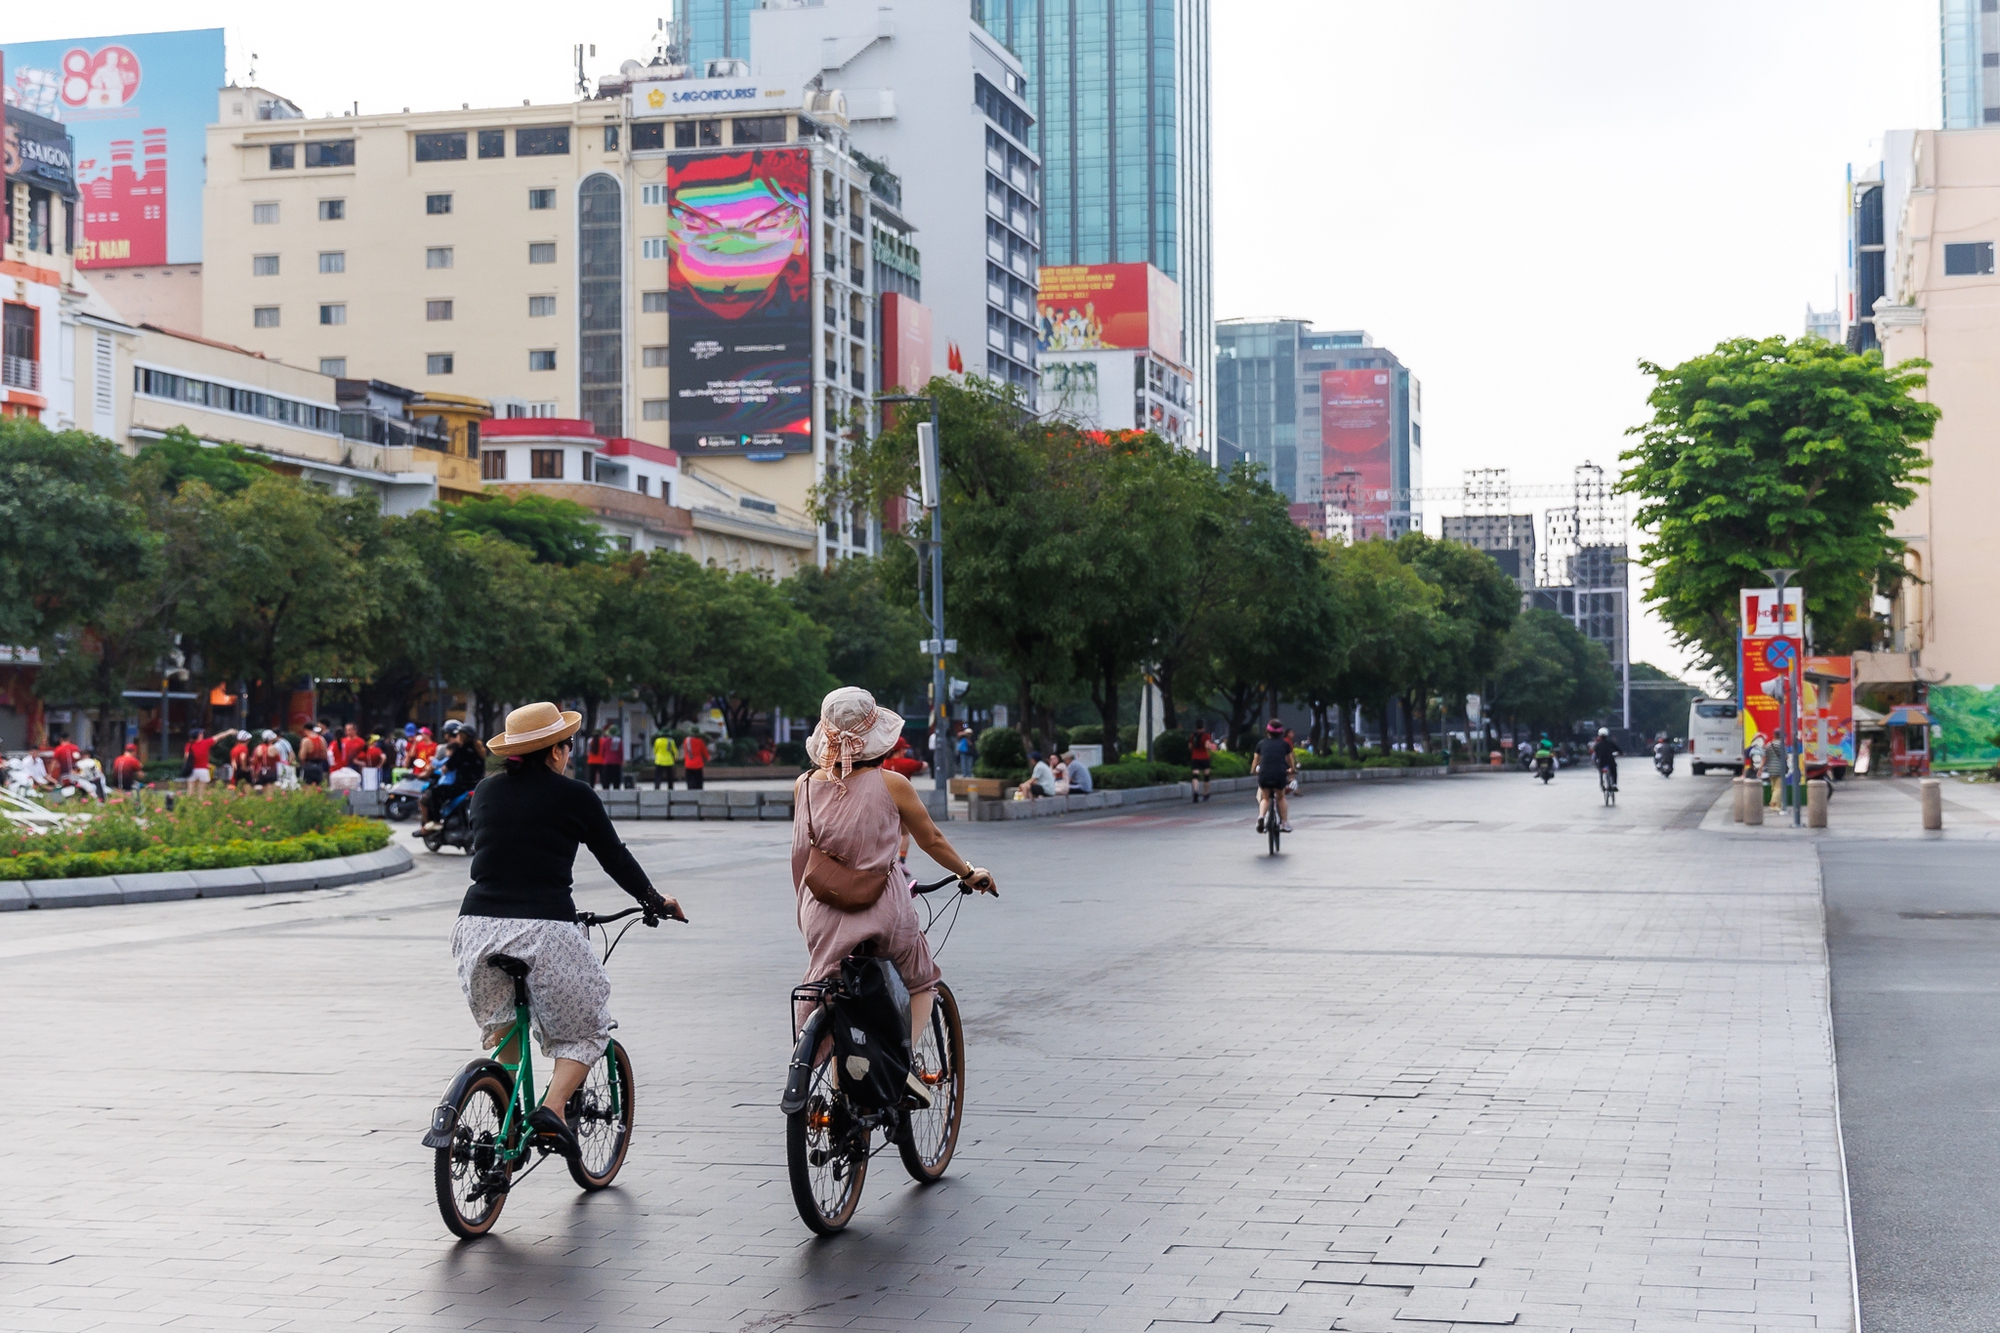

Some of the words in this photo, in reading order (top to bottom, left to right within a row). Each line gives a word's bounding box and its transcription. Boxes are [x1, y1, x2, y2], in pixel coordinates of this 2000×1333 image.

[672, 87, 757, 103] SAIGONTOURIST
[26, 140, 72, 171] SAIGON
[99, 239, 130, 260] NAM
